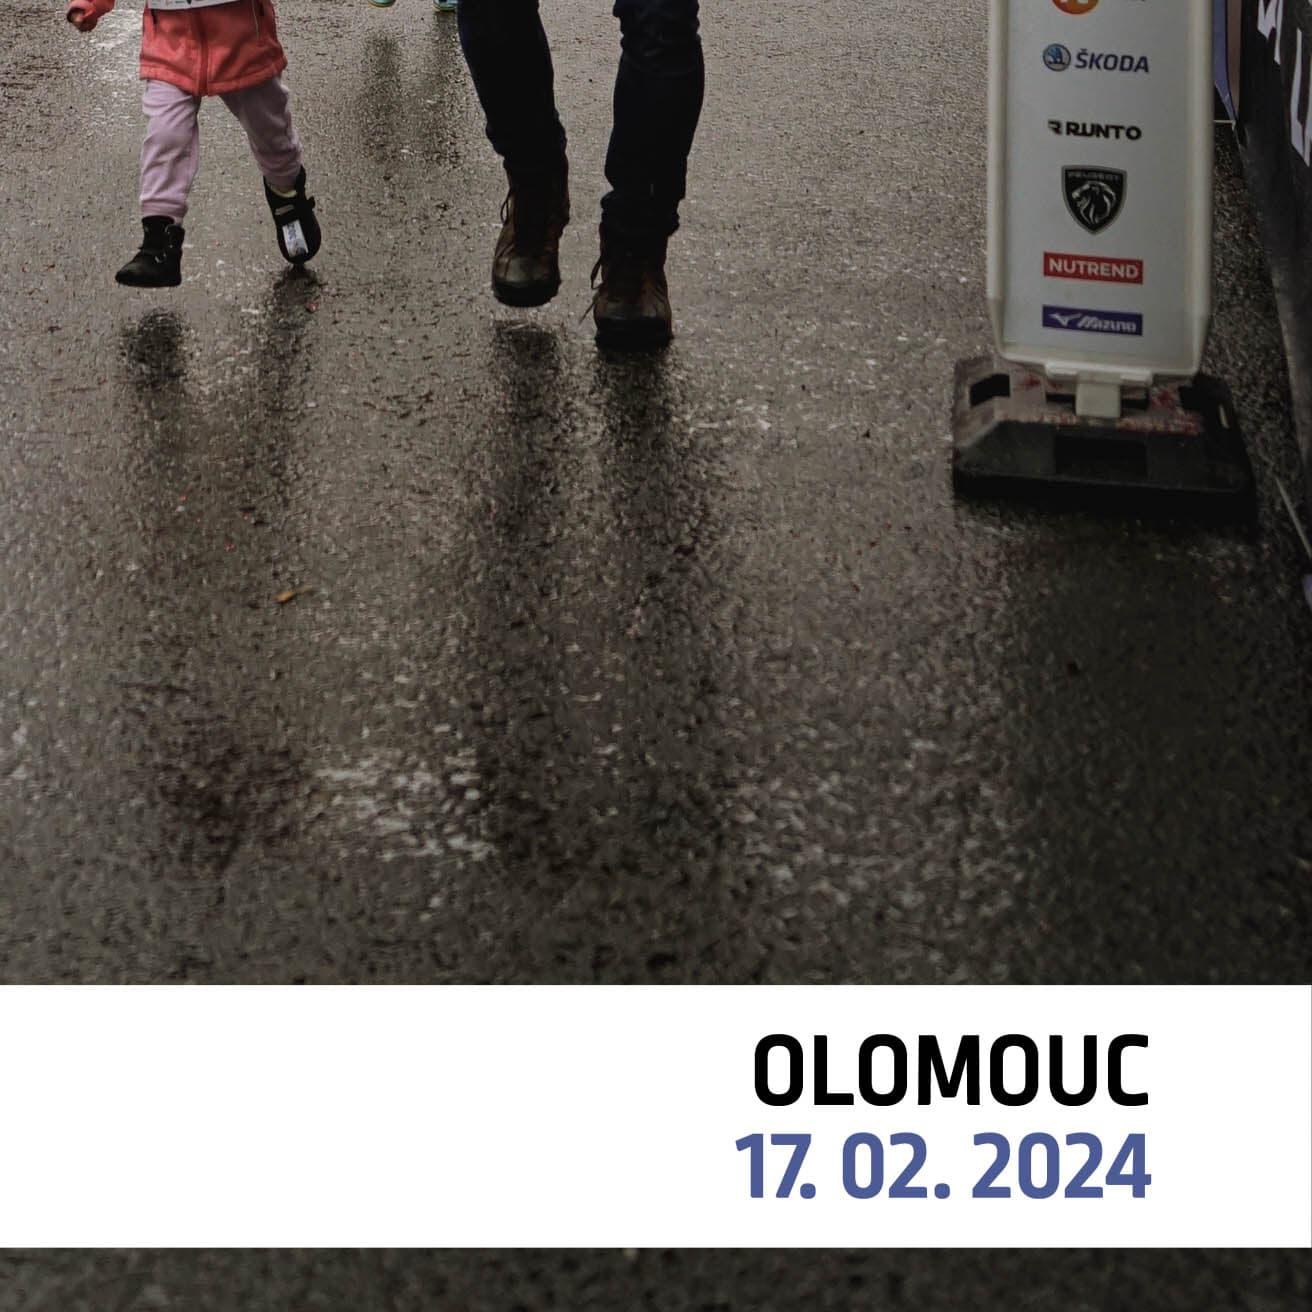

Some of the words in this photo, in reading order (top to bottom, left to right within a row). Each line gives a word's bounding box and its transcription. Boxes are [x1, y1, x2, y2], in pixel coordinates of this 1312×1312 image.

[1075, 47, 1150, 74] ŠKODA
[1065, 120, 1143, 141] RUNTO
[1048, 258, 1139, 279] NUTREND
